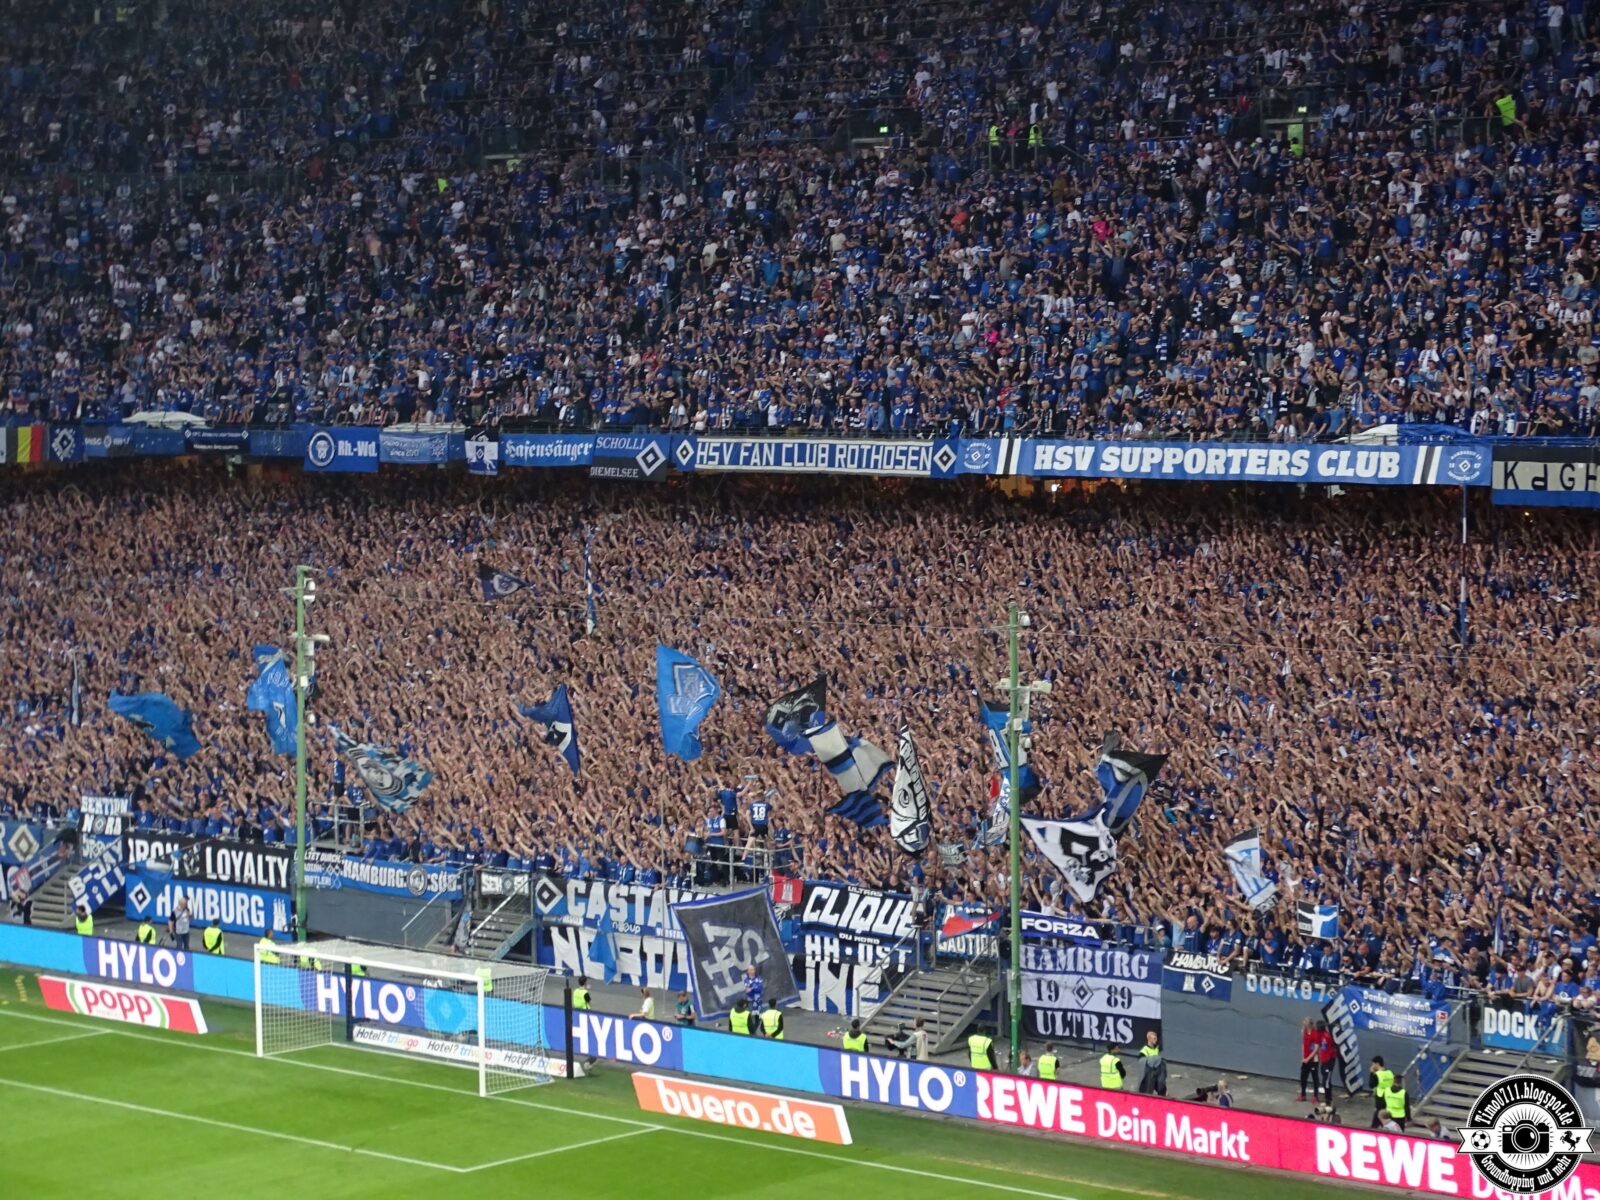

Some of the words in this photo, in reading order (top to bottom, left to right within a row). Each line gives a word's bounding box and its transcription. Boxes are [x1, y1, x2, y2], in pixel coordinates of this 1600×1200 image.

[595, 437, 646, 450] SCHOLLI
[696, 442, 731, 465] HSV
[739, 443, 774, 466] FAN
[781, 443, 828, 468] CLUB
[834, 444, 932, 470] ROTHOSEN
[589, 466, 639, 478] DIEMELSEE
[1033, 445, 1095, 471] HSV
[1099, 446, 1309, 477] SUPPORTERS
[1317, 450, 1400, 478] CLUB
[753, 806, 766, 820] 18
[205, 846, 289, 889] LOYALTY
[342, 859, 404, 888] HAMBURG
[847, 886, 883, 897] ULTRAS
[156, 884, 266, 929] HAMBURG
[803, 886, 916, 938] CLIQUE
[1021, 917, 1100, 939] FORZA
[1019, 945, 1150, 980] HAMBURG
[1170, 952, 1230, 974] HAMBURG
[81, 986, 153, 1023] popp
[1035, 979, 1060, 1003] 19
[1106, 985, 1133, 1010] 89
[1362, 990, 1387, 1004] Danke
[1035, 1009, 1134, 1044] ULTRAS
[1361, 1002, 1373, 1014] ich
[1375, 1007, 1388, 1016] ein
[1390, 1010, 1434, 1026] Hamburger
[356, 1028, 387, 1041] Hotel?
[387, 1034, 419, 1051] trivago
[427, 1040, 459, 1053] Hotel?
[503, 1053, 536, 1066] Hotel?
[537, 1058, 567, 1075] trivag
[656, 1078, 817, 1139] buero.de
[976, 1074, 1086, 1133] REWE
[1095, 1101, 1157, 1145] Dein
[1165, 1112, 1250, 1161] Markt
[1316, 1127, 1458, 1194] REWE
